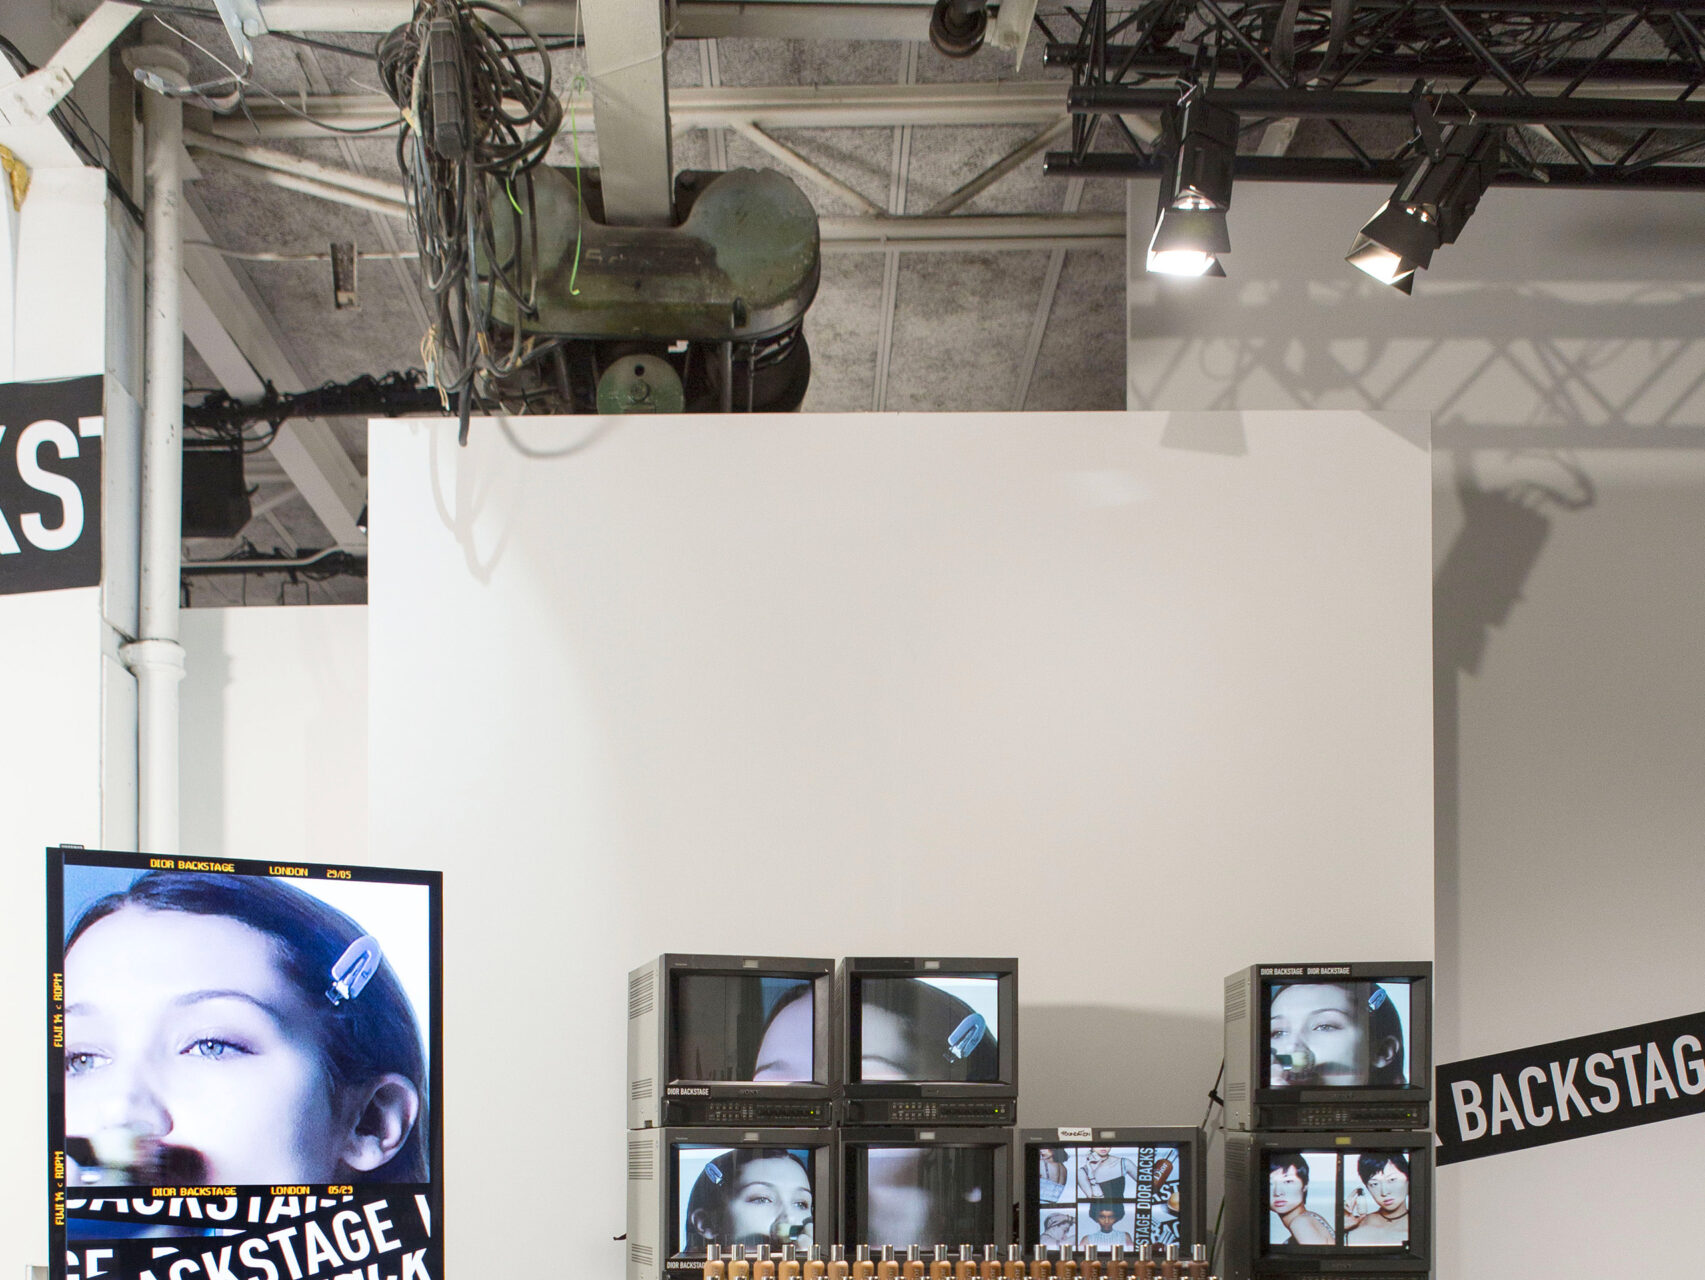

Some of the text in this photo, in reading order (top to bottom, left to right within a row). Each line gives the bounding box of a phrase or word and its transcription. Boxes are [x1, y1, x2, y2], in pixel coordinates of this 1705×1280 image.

[150, 858, 352, 879] DIOR BACKSTAGE LONDON 29/05
[1307, 967, 1320, 975] DIOR
[1321, 967, 1350, 975] BACKSTAGE
[53, 1025, 64, 1048] FUJI
[667, 1087, 710, 1096] DIOR BACKSTAGE
[1138, 1147, 1154, 1182] BACKS
[152, 1186, 353, 1197] DIOR BACKSTAGE LONDON 05/29
[1137, 1184, 1152, 1210] DIOR
[54, 1203, 65, 1226] FUJI
[666, 1261, 680, 1269] DIOR
